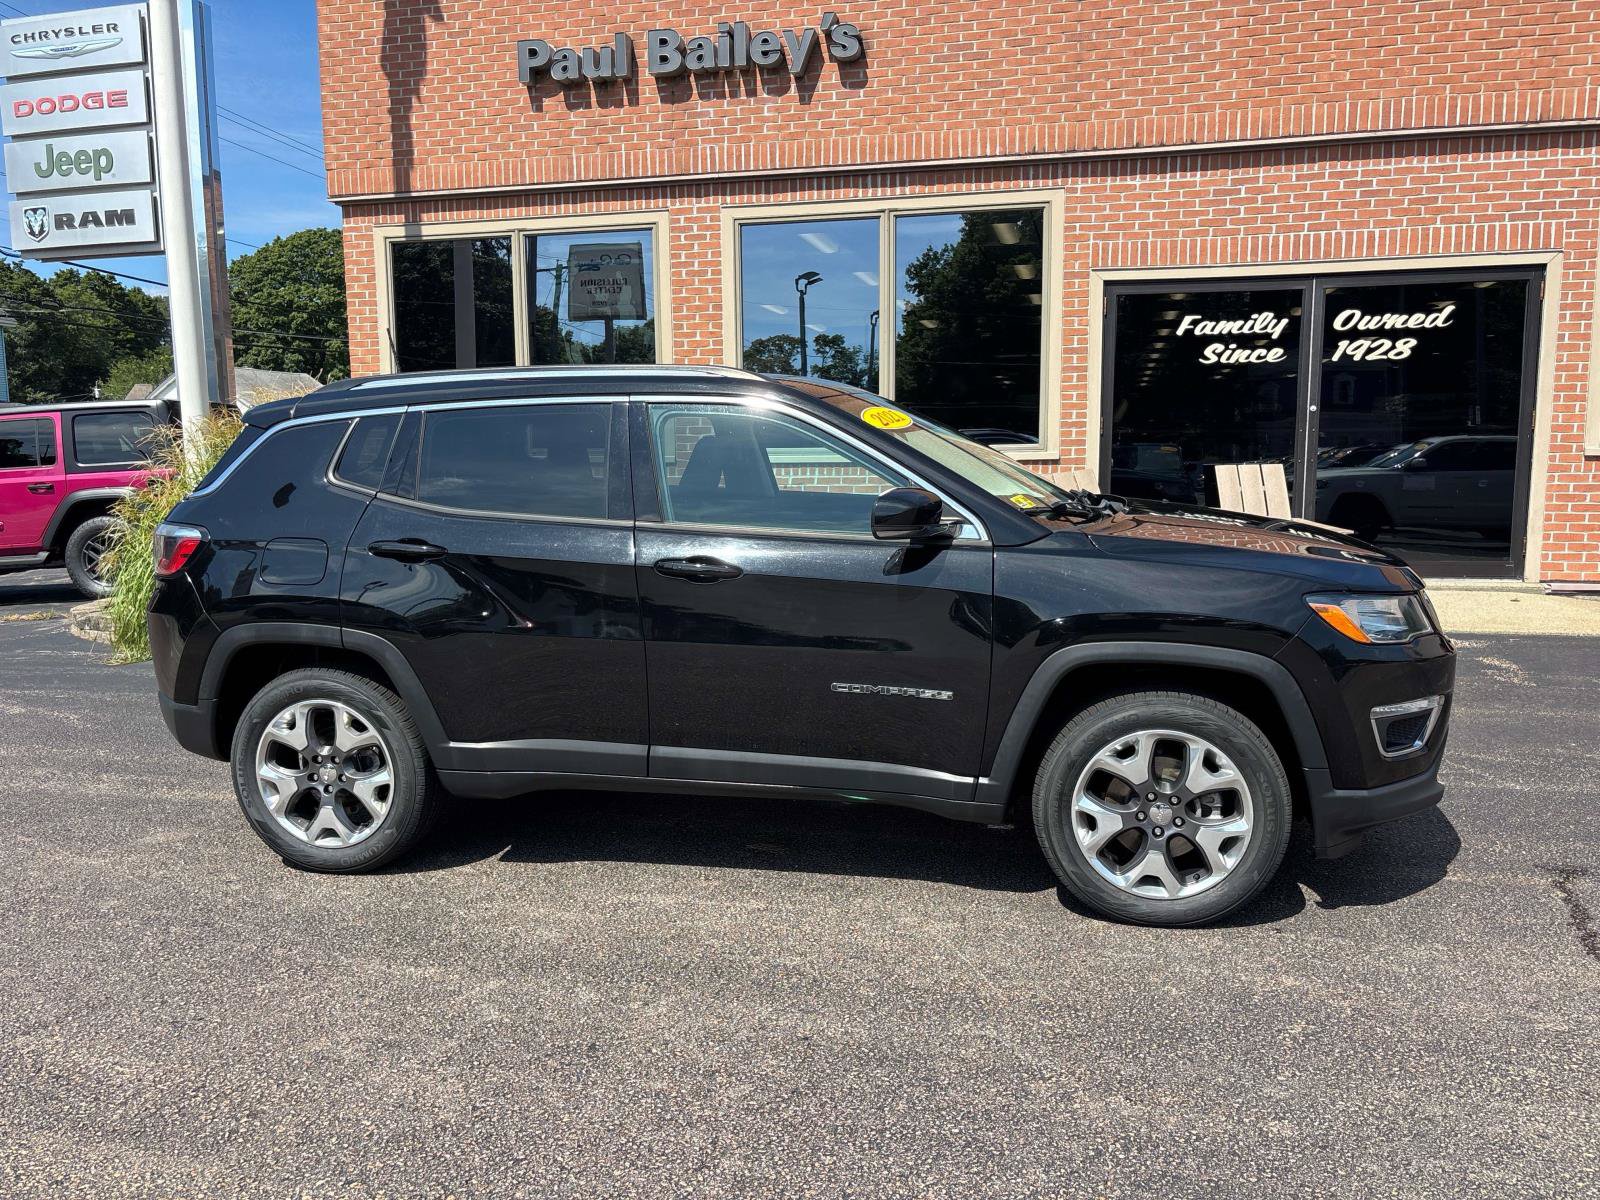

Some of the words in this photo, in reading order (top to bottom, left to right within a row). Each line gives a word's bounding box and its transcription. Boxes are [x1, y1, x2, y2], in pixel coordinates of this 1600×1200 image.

[10, 22, 121, 45] CHRYSLER
[517, 32, 632, 86] Paul
[647, 12, 862, 80] Bailey's
[13, 89, 129, 118] DODGE
[33, 143, 114, 181] Jeep
[54, 208, 137, 231] RAM
[1176, 311, 1290, 340] Family
[1332, 305, 1457, 331] Owned
[1199, 344, 1287, 364] Since
[1331, 338, 1418, 362] 1928
